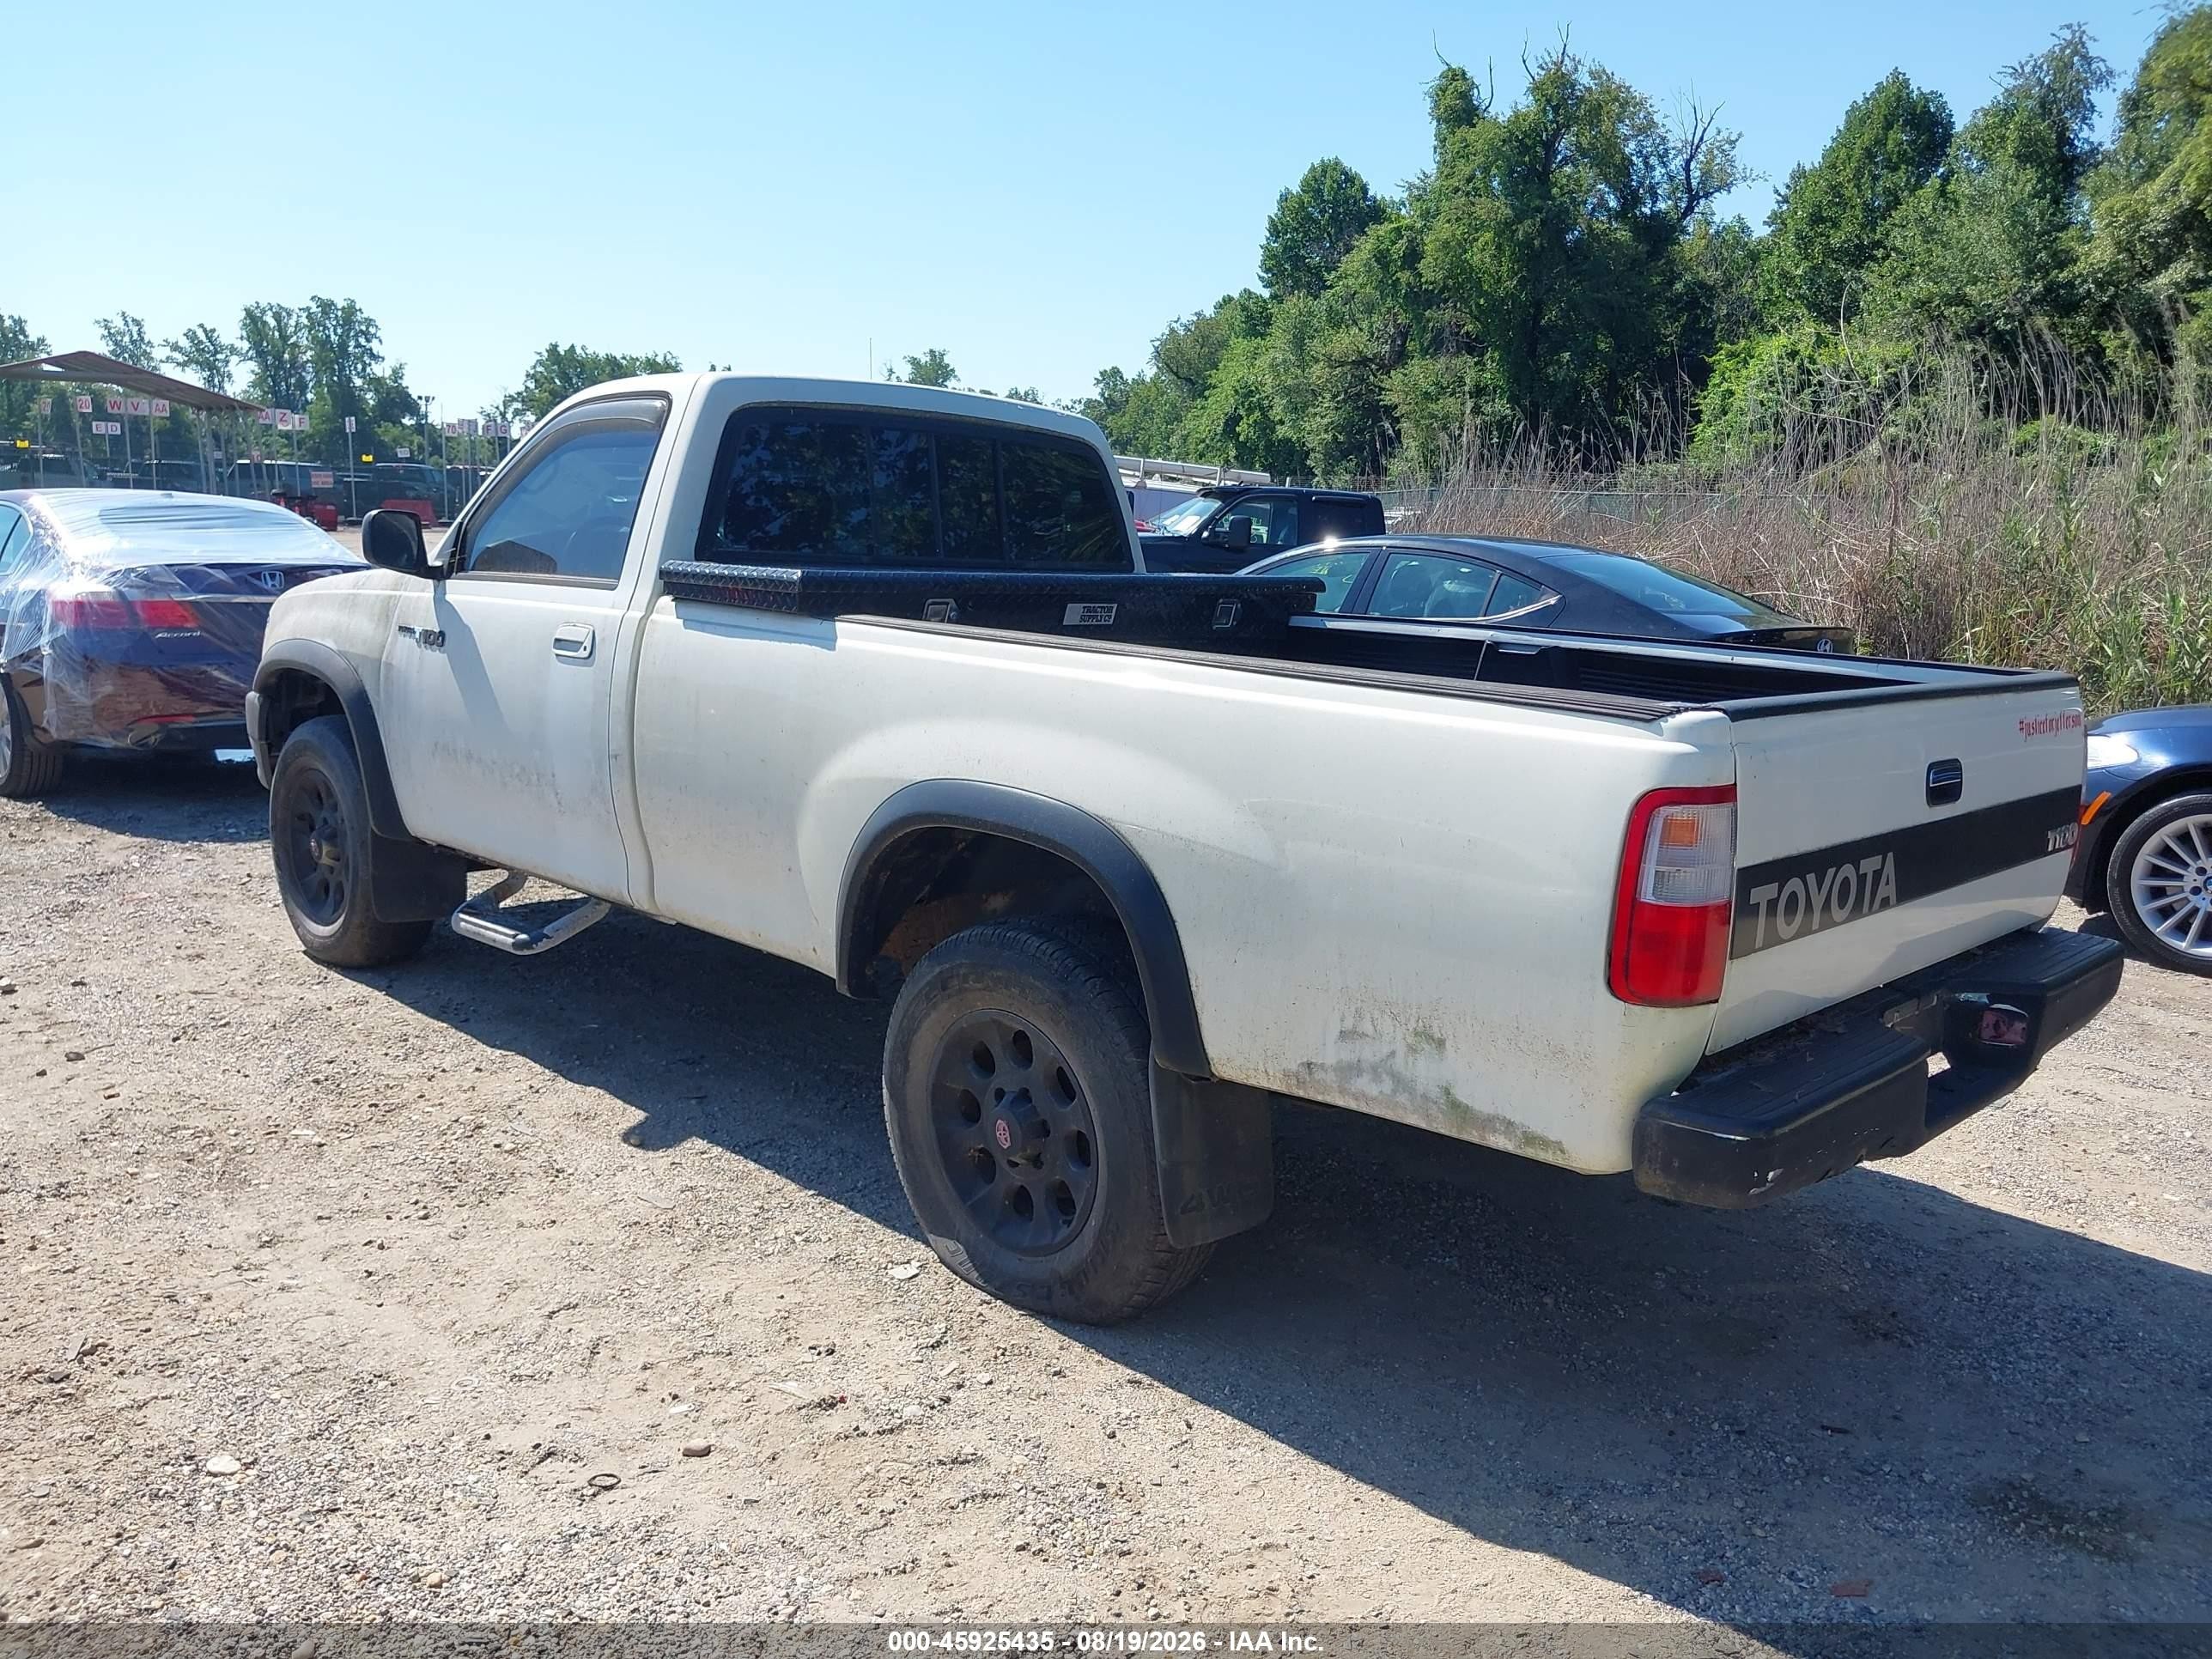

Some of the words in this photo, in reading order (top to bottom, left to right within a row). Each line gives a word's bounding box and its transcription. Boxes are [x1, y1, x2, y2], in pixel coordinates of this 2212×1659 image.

[79, 398, 90, 410] 20
[109, 399, 122, 410] W
[131, 401, 140, 411] V
[154, 403, 168, 414] AA
[279, 412, 288, 422] Z
[299, 417, 306, 427] F
[486, 425, 491, 434] F
[500, 425, 507, 434] G
[1082, 605, 1114, 614] TRACTOR
[1079, 614, 1103, 623] SUPPLY
[155, 630, 201, 639] Accord
[1749, 852, 1897, 949] TOYOTA
